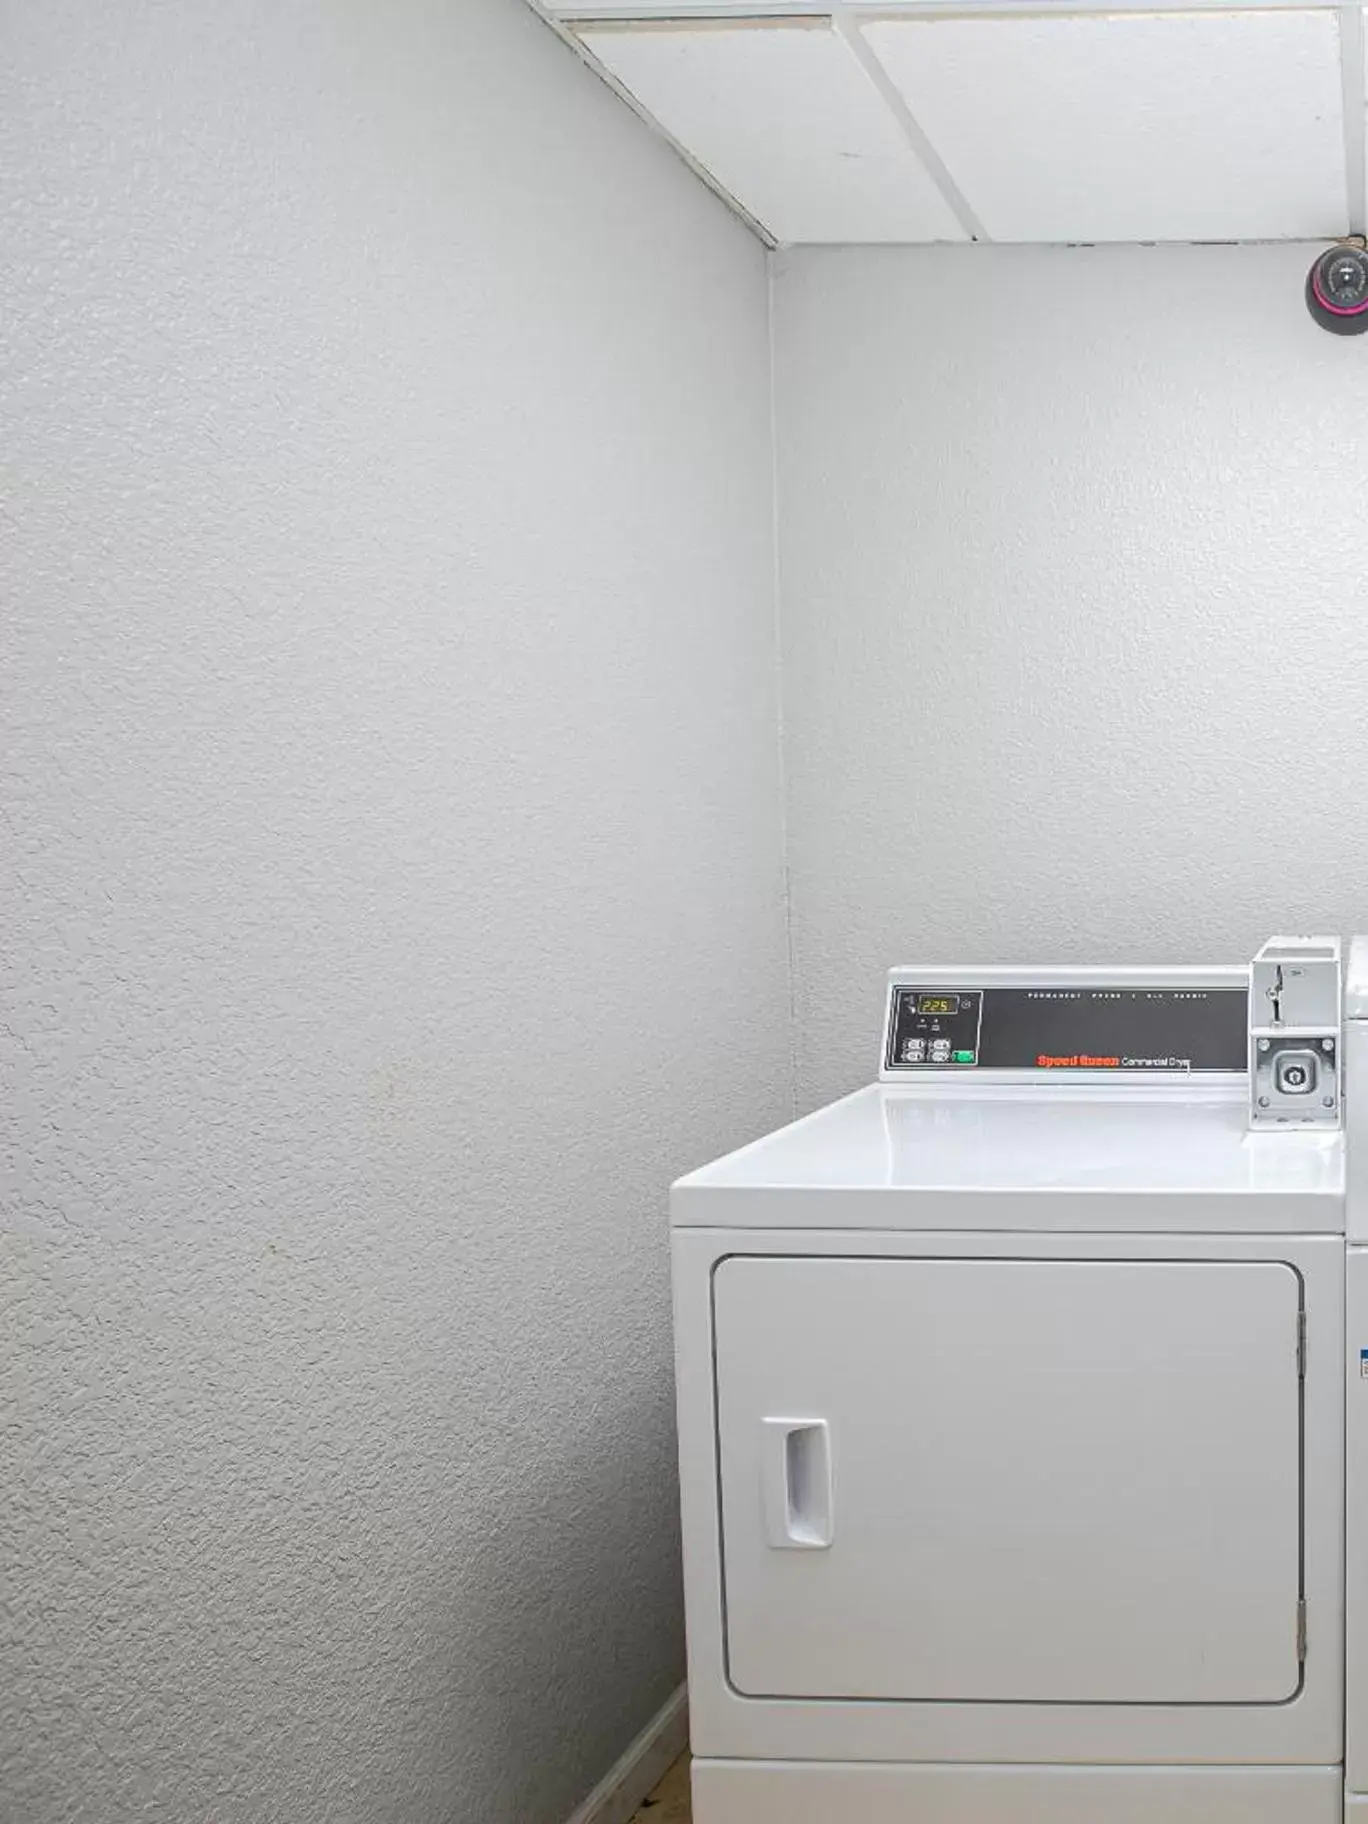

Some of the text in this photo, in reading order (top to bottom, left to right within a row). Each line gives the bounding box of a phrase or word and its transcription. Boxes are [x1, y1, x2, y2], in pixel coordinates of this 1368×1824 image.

[1037, 1054, 1078, 1069] Speed
[1079, 1054, 1120, 1067] Queen
[1121, 1056, 1168, 1067] Commercial
